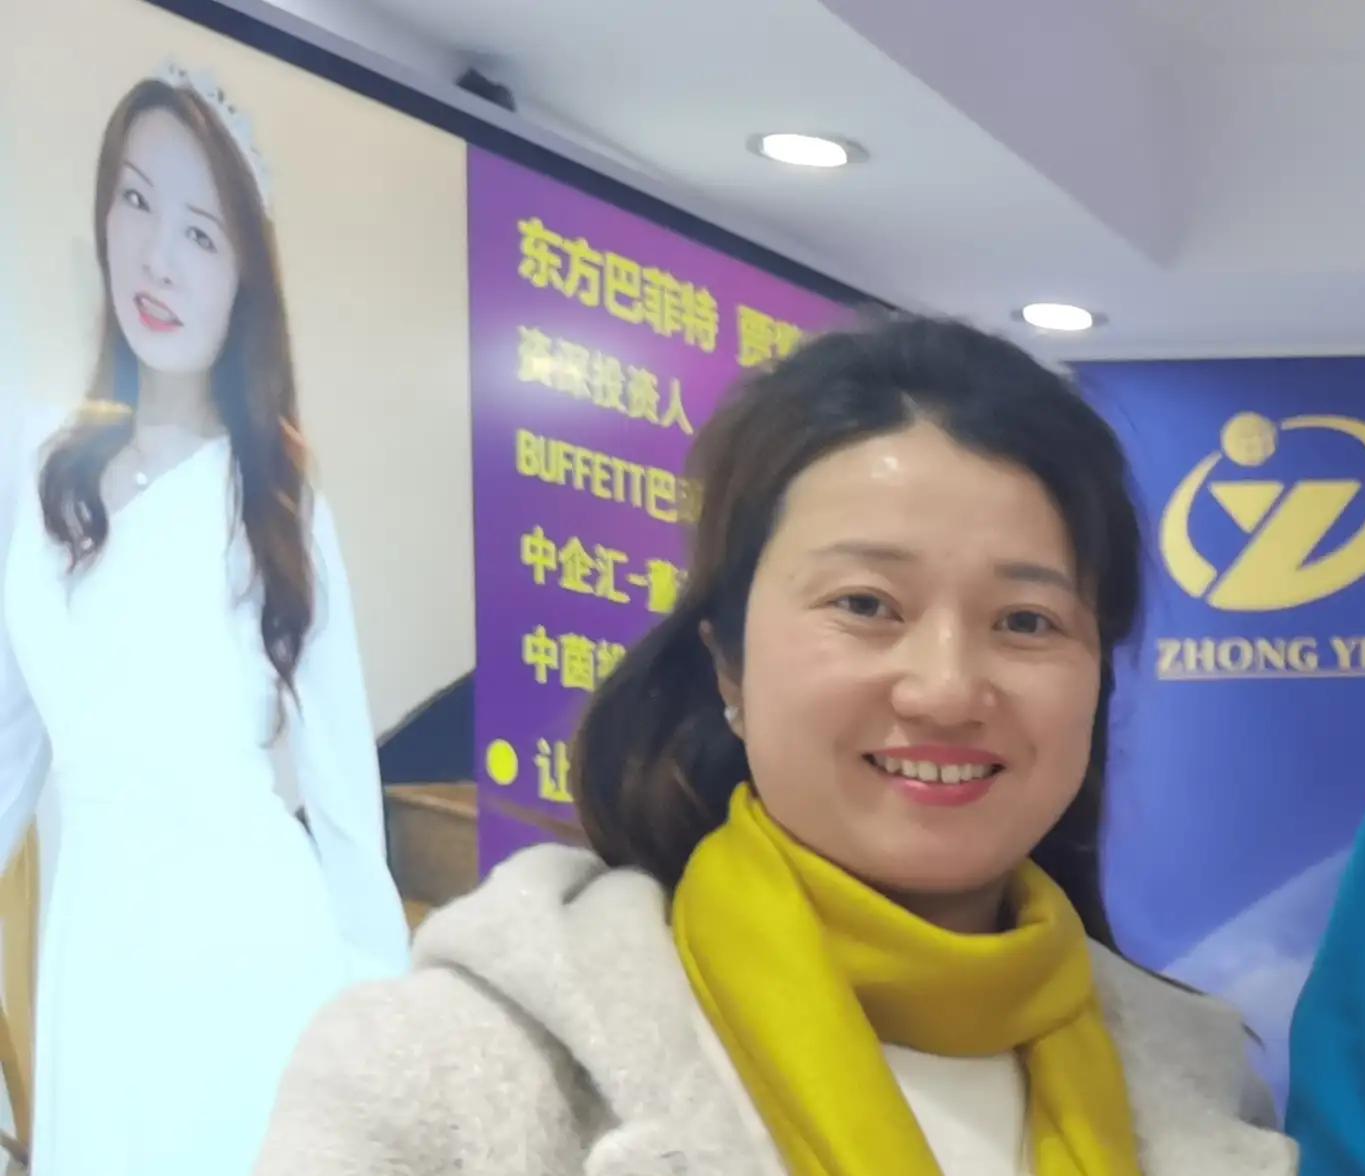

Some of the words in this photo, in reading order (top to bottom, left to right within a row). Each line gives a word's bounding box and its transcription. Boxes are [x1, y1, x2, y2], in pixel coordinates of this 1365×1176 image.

[516, 216, 720, 354] 东方巴菲特
[520, 524, 691, 615] 中企汇-董
[1157, 636, 1319, 673] ZHONG
